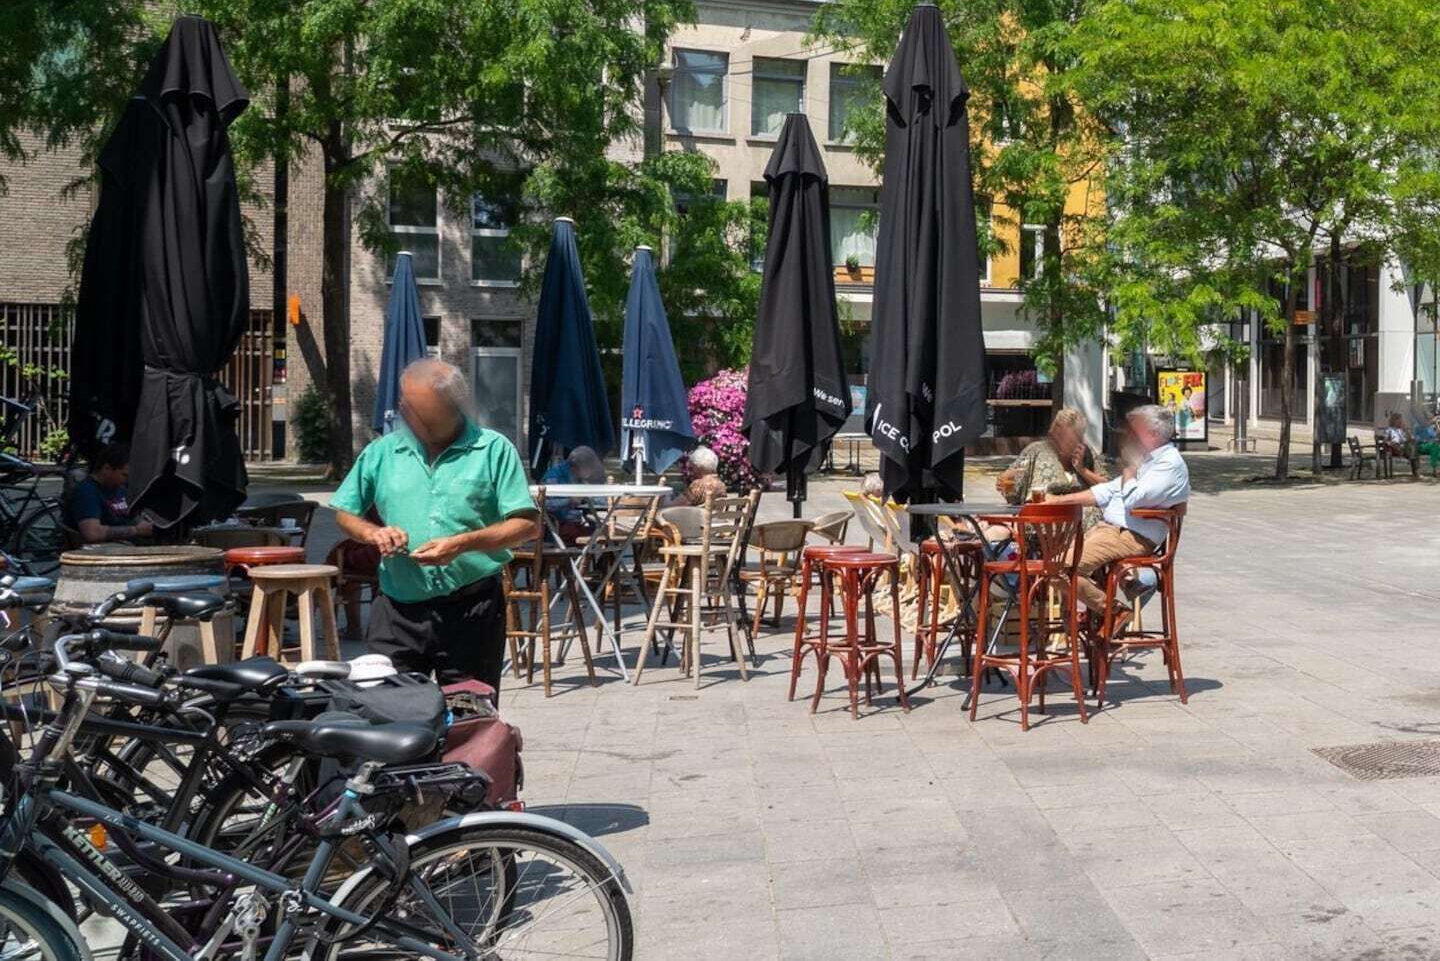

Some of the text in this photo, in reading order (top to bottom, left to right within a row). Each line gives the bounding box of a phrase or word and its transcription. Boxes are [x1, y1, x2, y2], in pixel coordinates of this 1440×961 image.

[877, 419, 911, 455] ICE C
[932, 421, 962, 444] POL
[62, 825, 122, 882] KETTLER
[110, 903, 161, 945] SWAPFIETS
